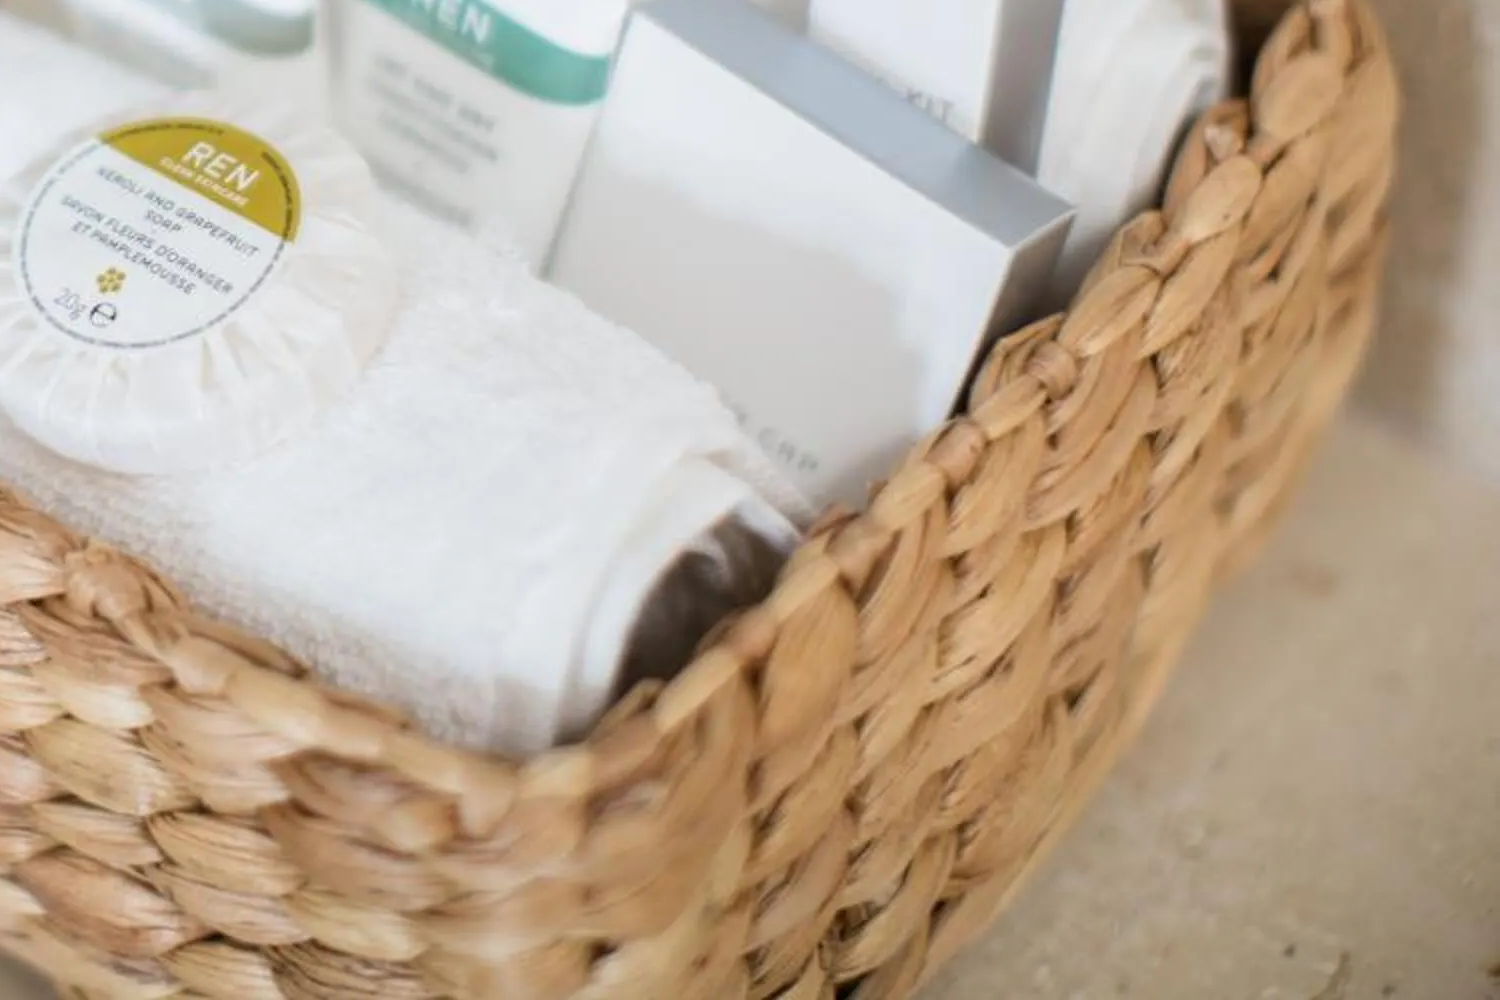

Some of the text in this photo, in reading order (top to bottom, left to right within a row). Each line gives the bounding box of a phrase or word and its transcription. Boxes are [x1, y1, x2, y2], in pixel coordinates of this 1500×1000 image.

[181, 141, 260, 191] REN
[97, 165, 260, 258] NEROLI AND GRAPEFRUIT
[145, 209, 183, 232] SOAP
[60, 194, 234, 293] SAVON FLEURS D'ORANGER
[71, 220, 92, 234] ET
[89, 229, 197, 295] PAMPLEMOUSSE
[53, 287, 88, 321] 20g
